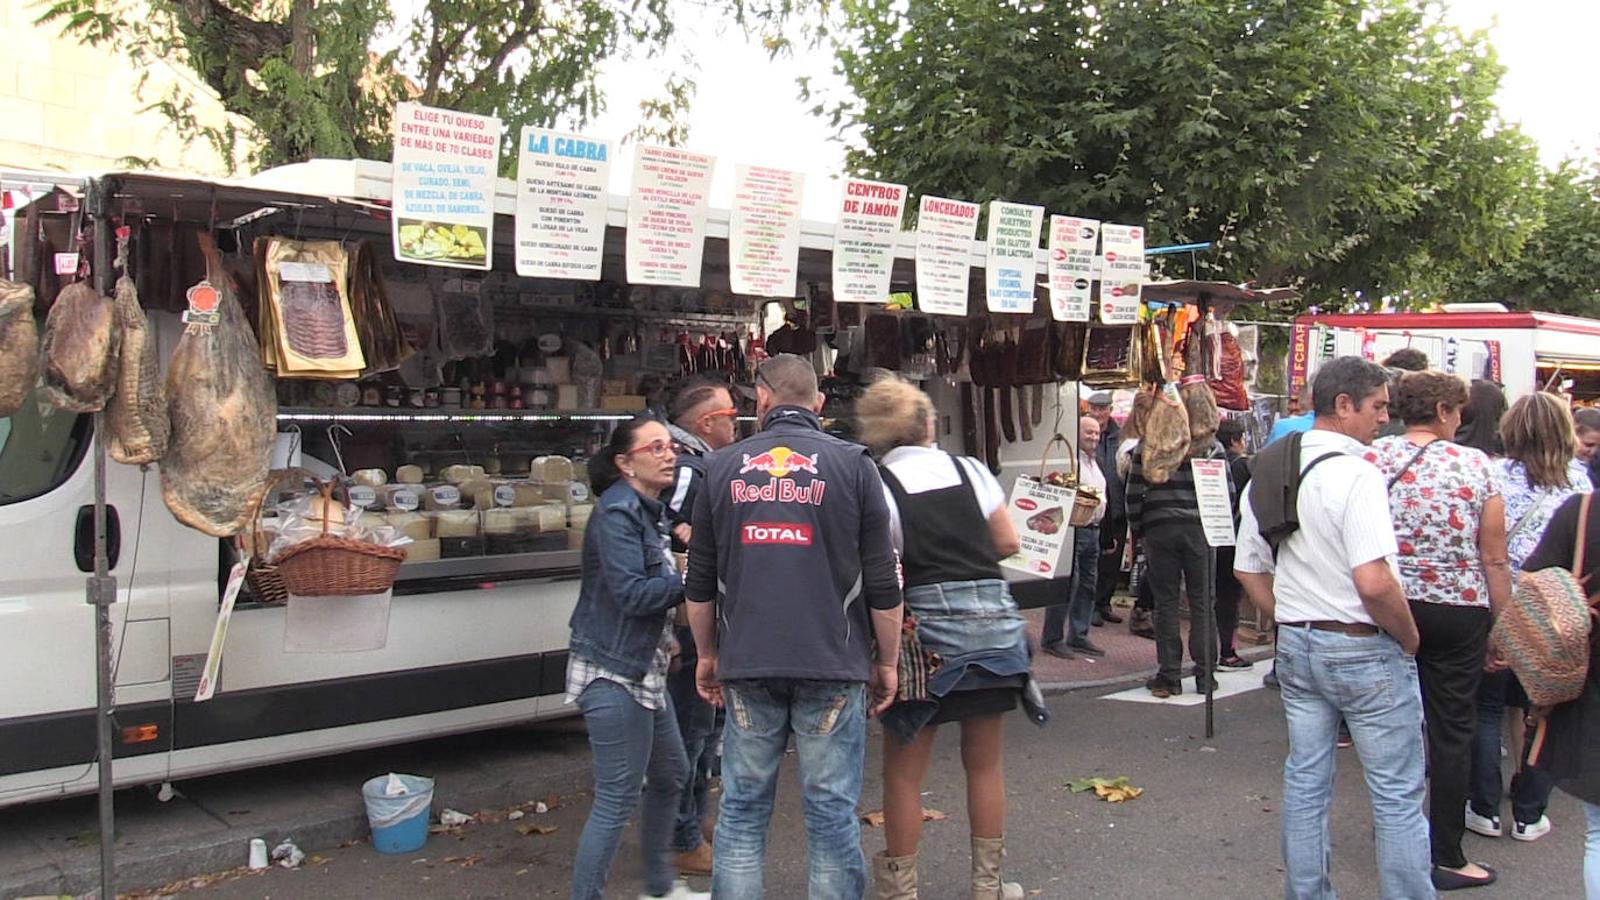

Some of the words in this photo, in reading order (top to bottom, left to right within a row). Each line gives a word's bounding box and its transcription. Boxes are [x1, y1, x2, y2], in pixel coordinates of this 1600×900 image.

[414, 110, 439, 122] ELIGE
[442, 115, 453, 125] TU
[456, 117, 484, 130] QUESO
[401, 123, 430, 135] ENTRE
[433, 128, 450, 138] UNA
[454, 131, 494, 145] VARIEDAD
[400, 137, 412, 147] DE
[436, 143, 447, 152] DE
[450, 144, 460, 154] 70
[461, 146, 493, 159] CLASES
[528, 134, 549, 154] LA
[555, 137, 607, 162] CABRA
[580, 165, 596, 173] CABRA
[847, 182, 901, 200] CENTROS
[567, 208, 584, 216] CABRA
[843, 200, 859, 213] DE
[862, 201, 899, 218] JAMÓN
[923, 199, 976, 218] LONCHEADOS
[1001, 207, 1032, 218] CONSULTE
[1000, 217, 1032, 227] NUESTROS
[996, 227, 1032, 237] PRODUCTOS
[1008, 250, 1033, 258] LACTOSA
[731, 477, 777, 503] Red
[779, 478, 826, 505] Bull
[745, 525, 808, 541] TOTAL
